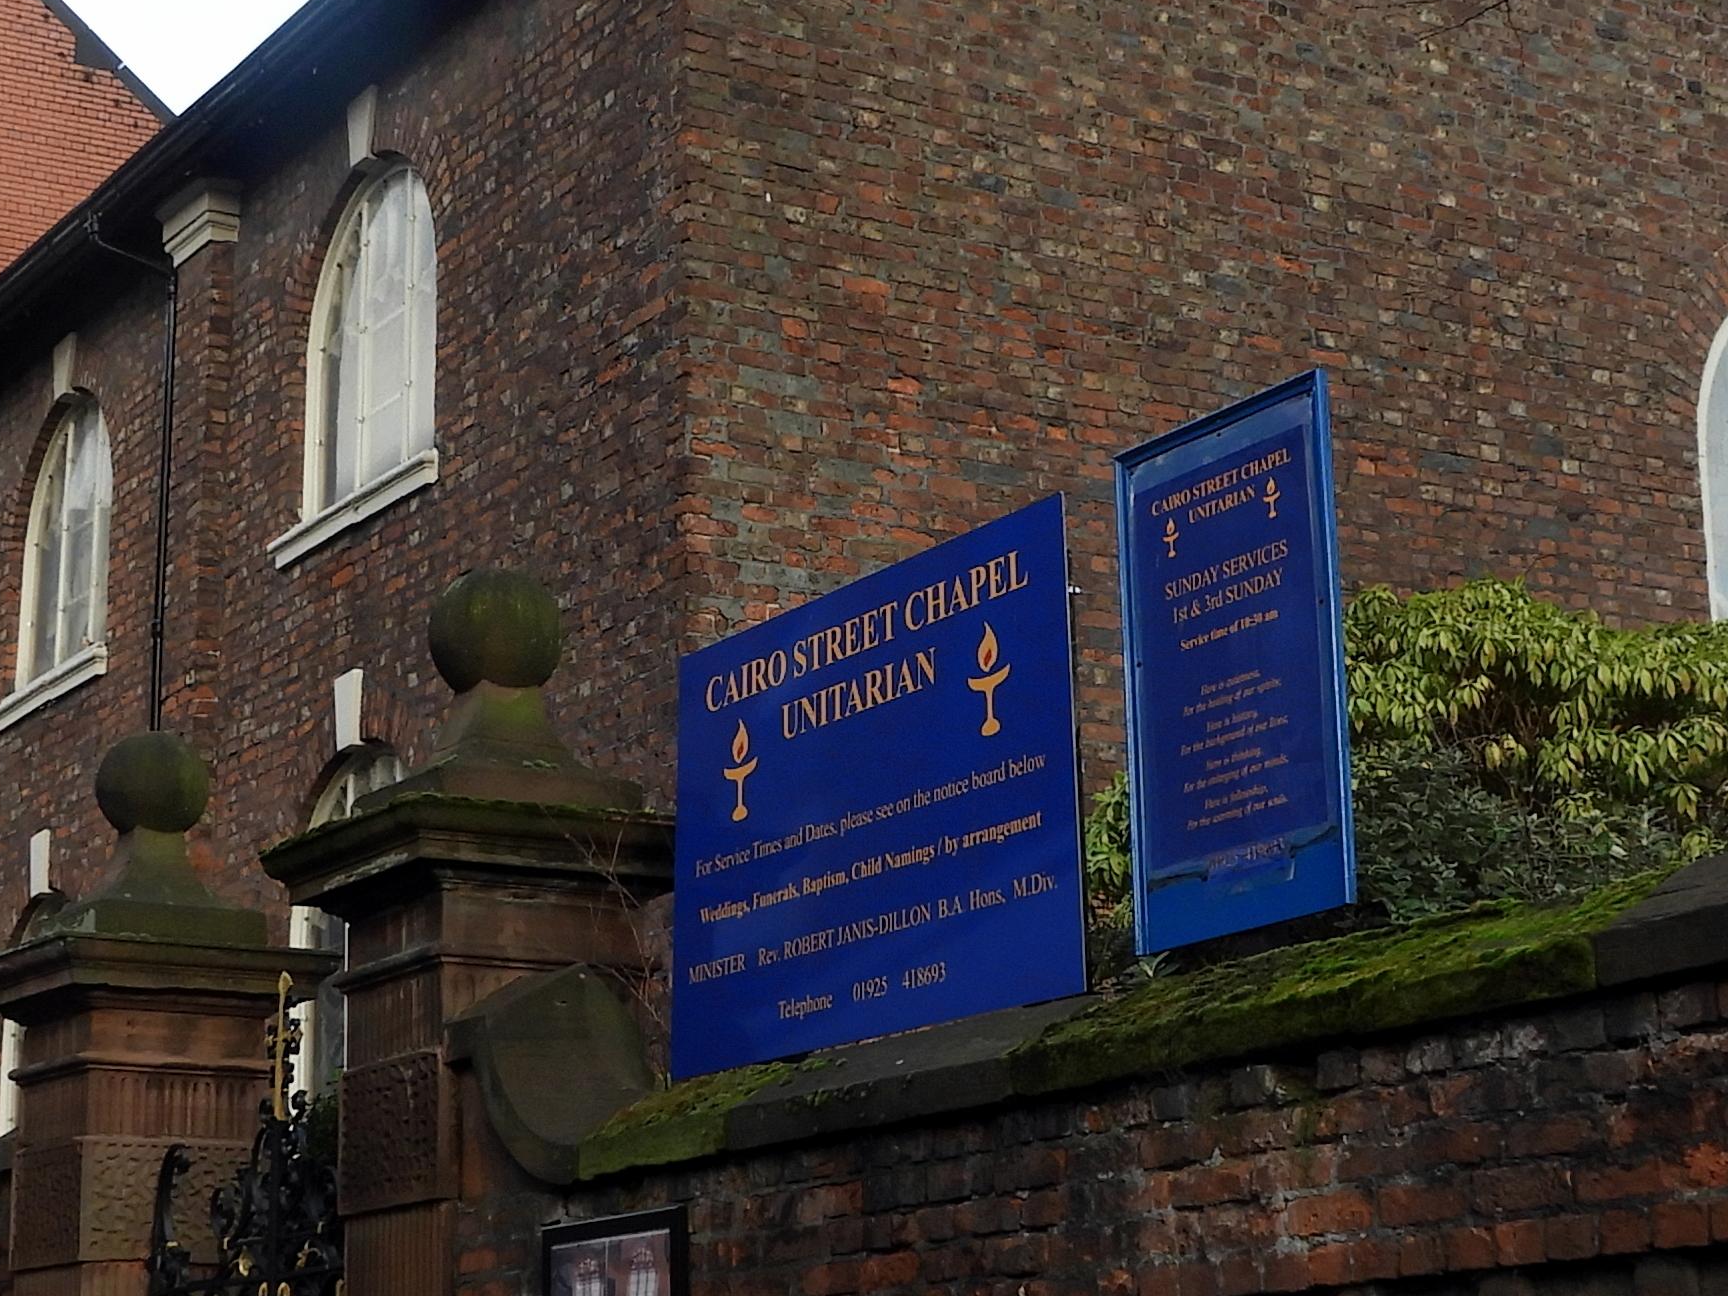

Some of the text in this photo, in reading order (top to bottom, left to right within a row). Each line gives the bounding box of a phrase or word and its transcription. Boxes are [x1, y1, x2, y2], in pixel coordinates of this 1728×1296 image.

[1151, 447, 1292, 517] CAIRO STREET CHAPEL
[1187, 484, 1256, 524] UNITARIAN
[1164, 538, 1289, 601] SUNDAY SERVICES
[1172, 567, 1284, 624] 1st & 3rd SUNDAY
[705, 550, 1029, 713] CAIRO STREET CHAPEL
[1179, 631, 1210, 652] Service
[1229, 619, 1239, 634] of
[782, 647, 937, 740] UNITARIAN
[696, 858, 712, 878] For
[714, 848, 751, 873] Service
[753, 838, 782, 860] Times
[784, 827, 803, 850] and
[840, 808, 874, 837] please
[875, 804, 894, 820] see
[896, 797, 911, 814] on
[913, 789, 931, 808] the
[933, 778, 969, 802] notice
[971, 761, 1006, 790] board
[1008, 753, 1046, 779] below
[699, 899, 751, 925] Weddings,
[803, 870, 850, 897] Baptism,
[851, 858, 882, 880] Child
[884, 842, 935, 871] Namings
[937, 837, 944, 857] /
[945, 836, 960, 856] by
[962, 810, 1043, 850] arrangement
[688, 953, 747, 985] MINISTER
[758, 947, 782, 967] Rev.
[783, 928, 835, 961] ROBERT
[836, 902, 931, 946] JANIS-DILLON
[778, 962, 946, 1021] Telephone 01925 418693
